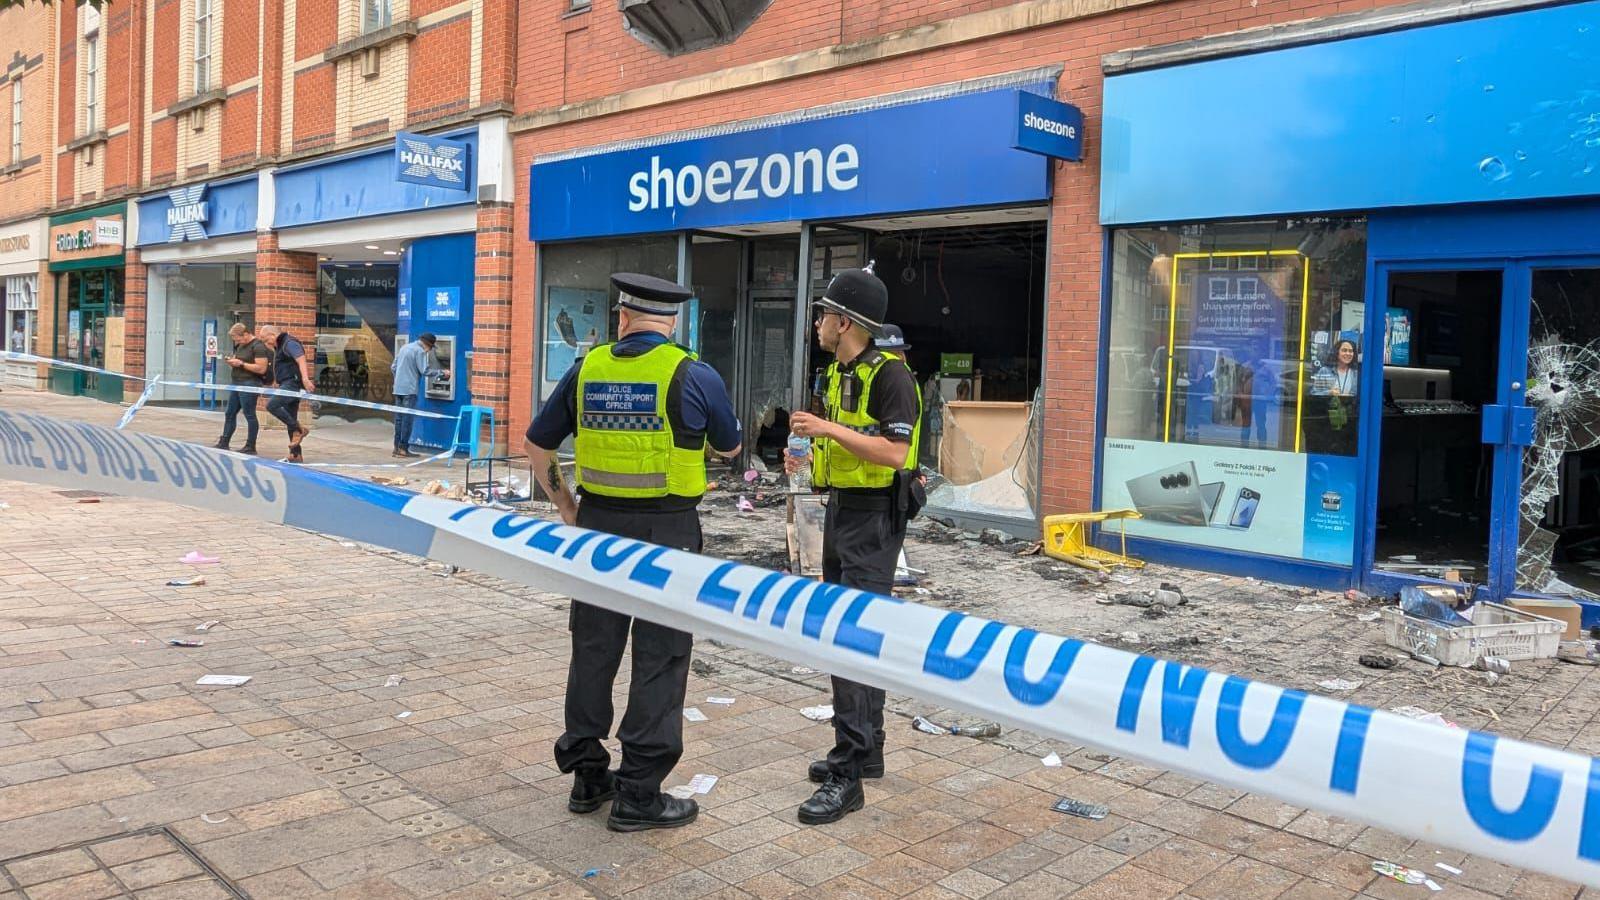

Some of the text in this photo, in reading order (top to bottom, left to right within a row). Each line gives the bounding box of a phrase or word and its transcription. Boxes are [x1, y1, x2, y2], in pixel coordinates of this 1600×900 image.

[1024, 112, 1075, 139] shoezone
[400, 151, 463, 171] HALIFAX
[628, 143, 859, 212] shoezone
[168, 202, 206, 226] HALIFAX
[1243, 302, 1272, 311] before.
[957, 359, 970, 368] £10
[608, 385, 632, 393] POLICE
[586, 393, 623, 401] COMMUNITY
[605, 401, 633, 410] OFFICER
[1214, 461, 1234, 470] Galaxy
